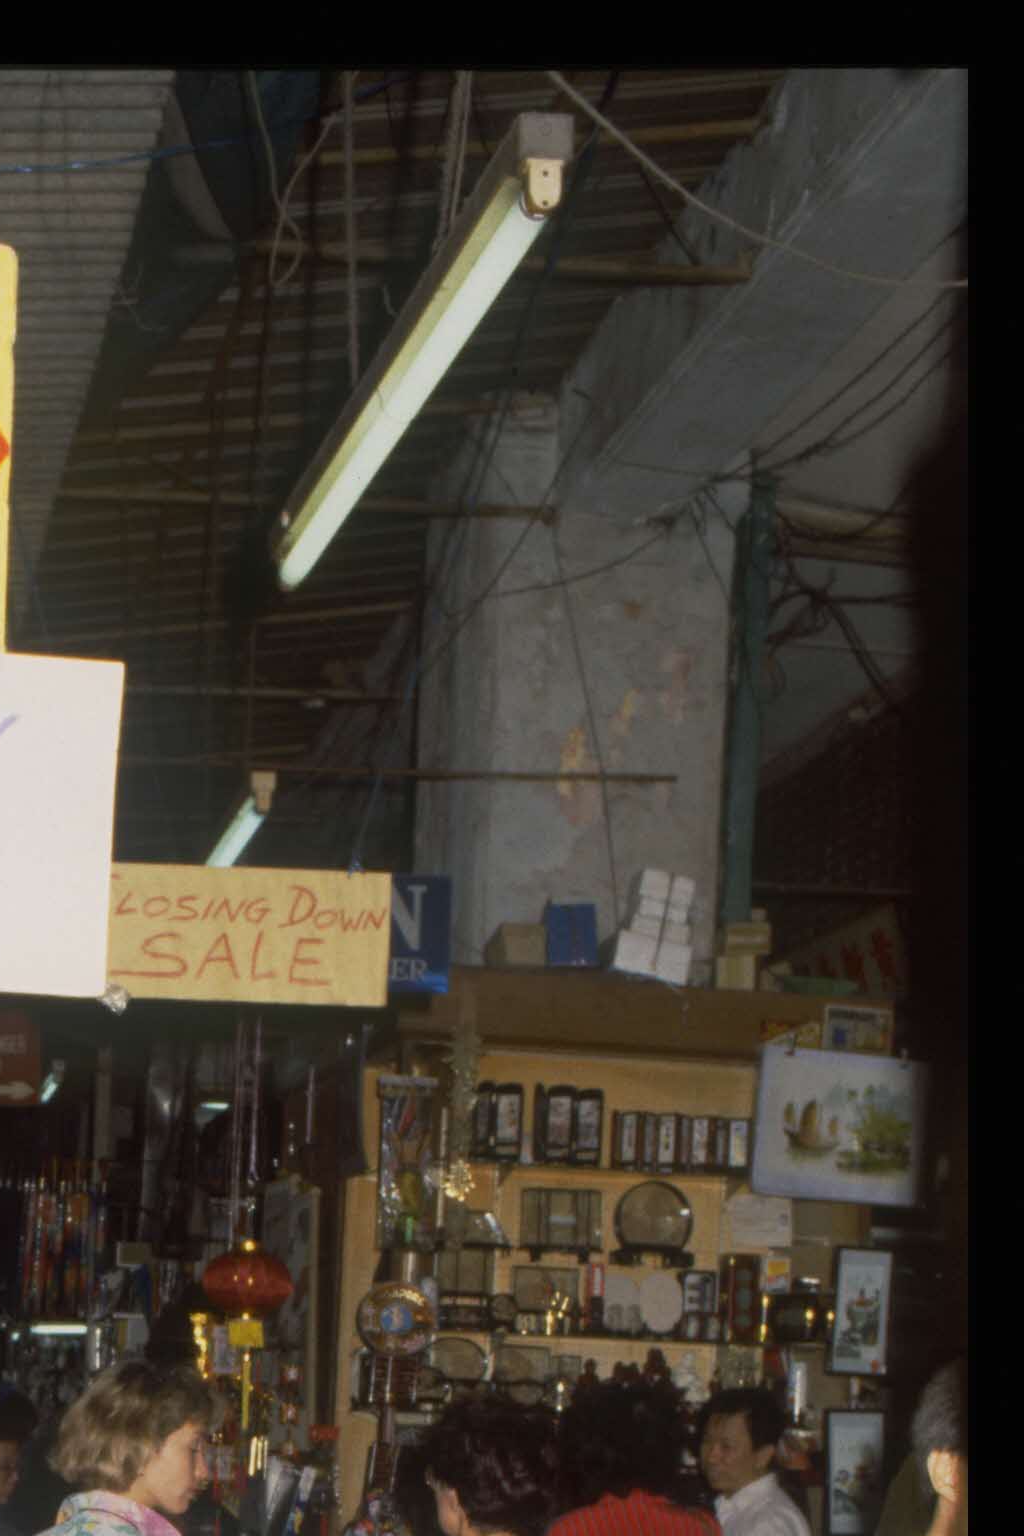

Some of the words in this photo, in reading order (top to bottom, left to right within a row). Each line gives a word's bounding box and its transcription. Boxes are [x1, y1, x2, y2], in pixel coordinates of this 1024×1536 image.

[111, 873, 273, 925] LOSING
[279, 885, 388, 932] DOWN
[109, 932, 332, 987] SALE
